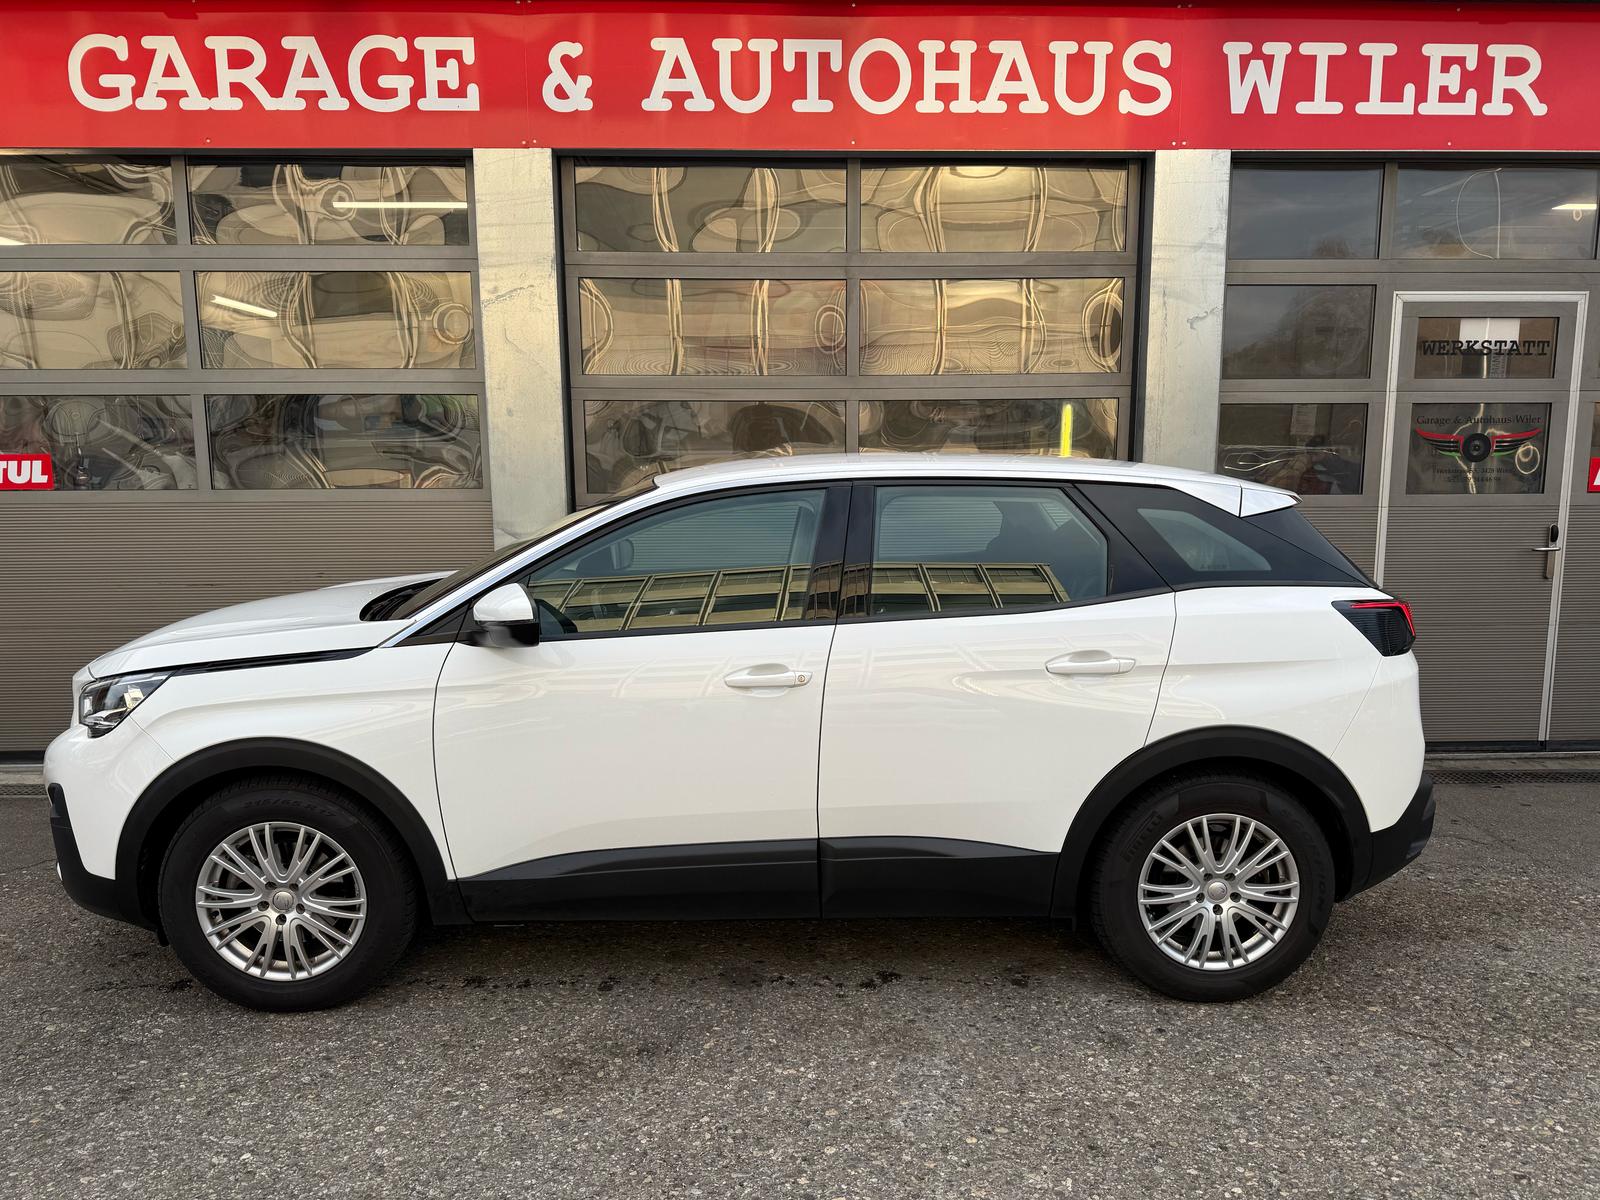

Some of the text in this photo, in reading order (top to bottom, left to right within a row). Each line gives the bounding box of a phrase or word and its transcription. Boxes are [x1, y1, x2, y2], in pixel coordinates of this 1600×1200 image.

[67, 34, 1548, 116] GARAGE & AUTOHAUS WILER
[1421, 340, 1551, 356] WERKSTATT
[1416, 414, 1542, 425] Garage & Autohaus Wiler
